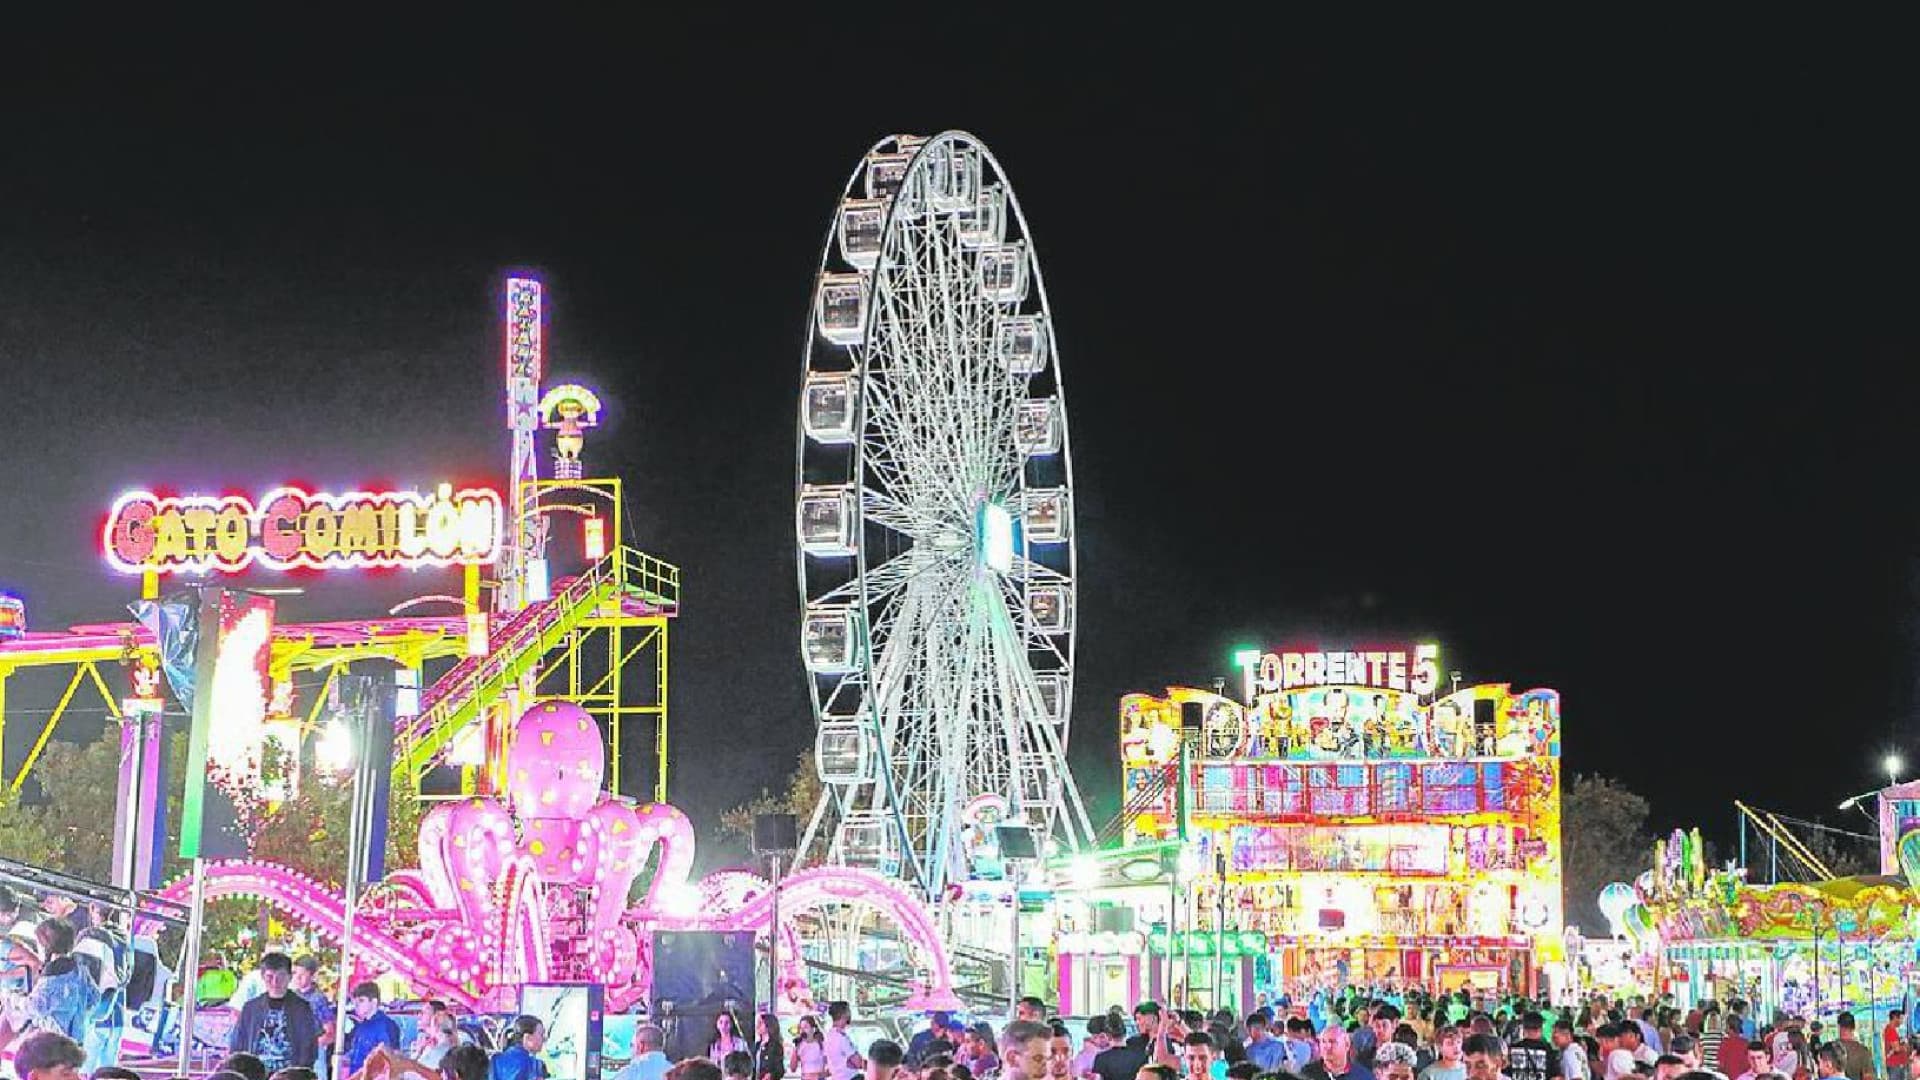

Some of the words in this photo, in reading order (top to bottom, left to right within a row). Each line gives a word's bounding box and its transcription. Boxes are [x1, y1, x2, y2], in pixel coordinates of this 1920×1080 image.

[116, 500, 249, 562] GATO
[263, 484, 494, 558] COMILÓN
[1235, 649, 1406, 697] TORRENTE
[1411, 644, 1438, 696] 5
